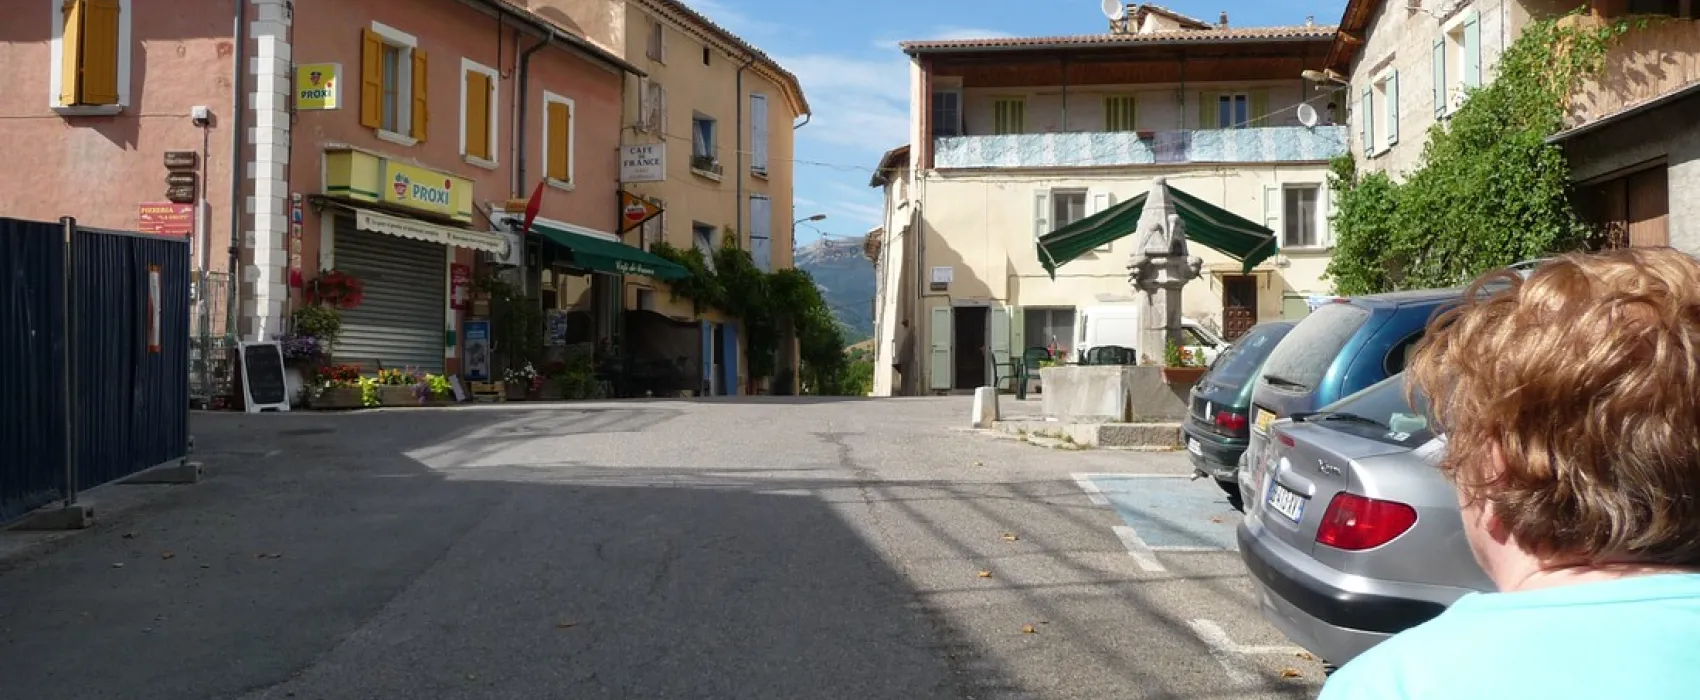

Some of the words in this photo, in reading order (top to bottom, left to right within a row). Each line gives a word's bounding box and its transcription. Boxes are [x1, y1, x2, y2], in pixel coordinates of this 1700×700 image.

[301, 82, 332, 99] PROXI
[623, 158, 660, 167] FRANCE
[412, 179, 450, 205] PROXI
